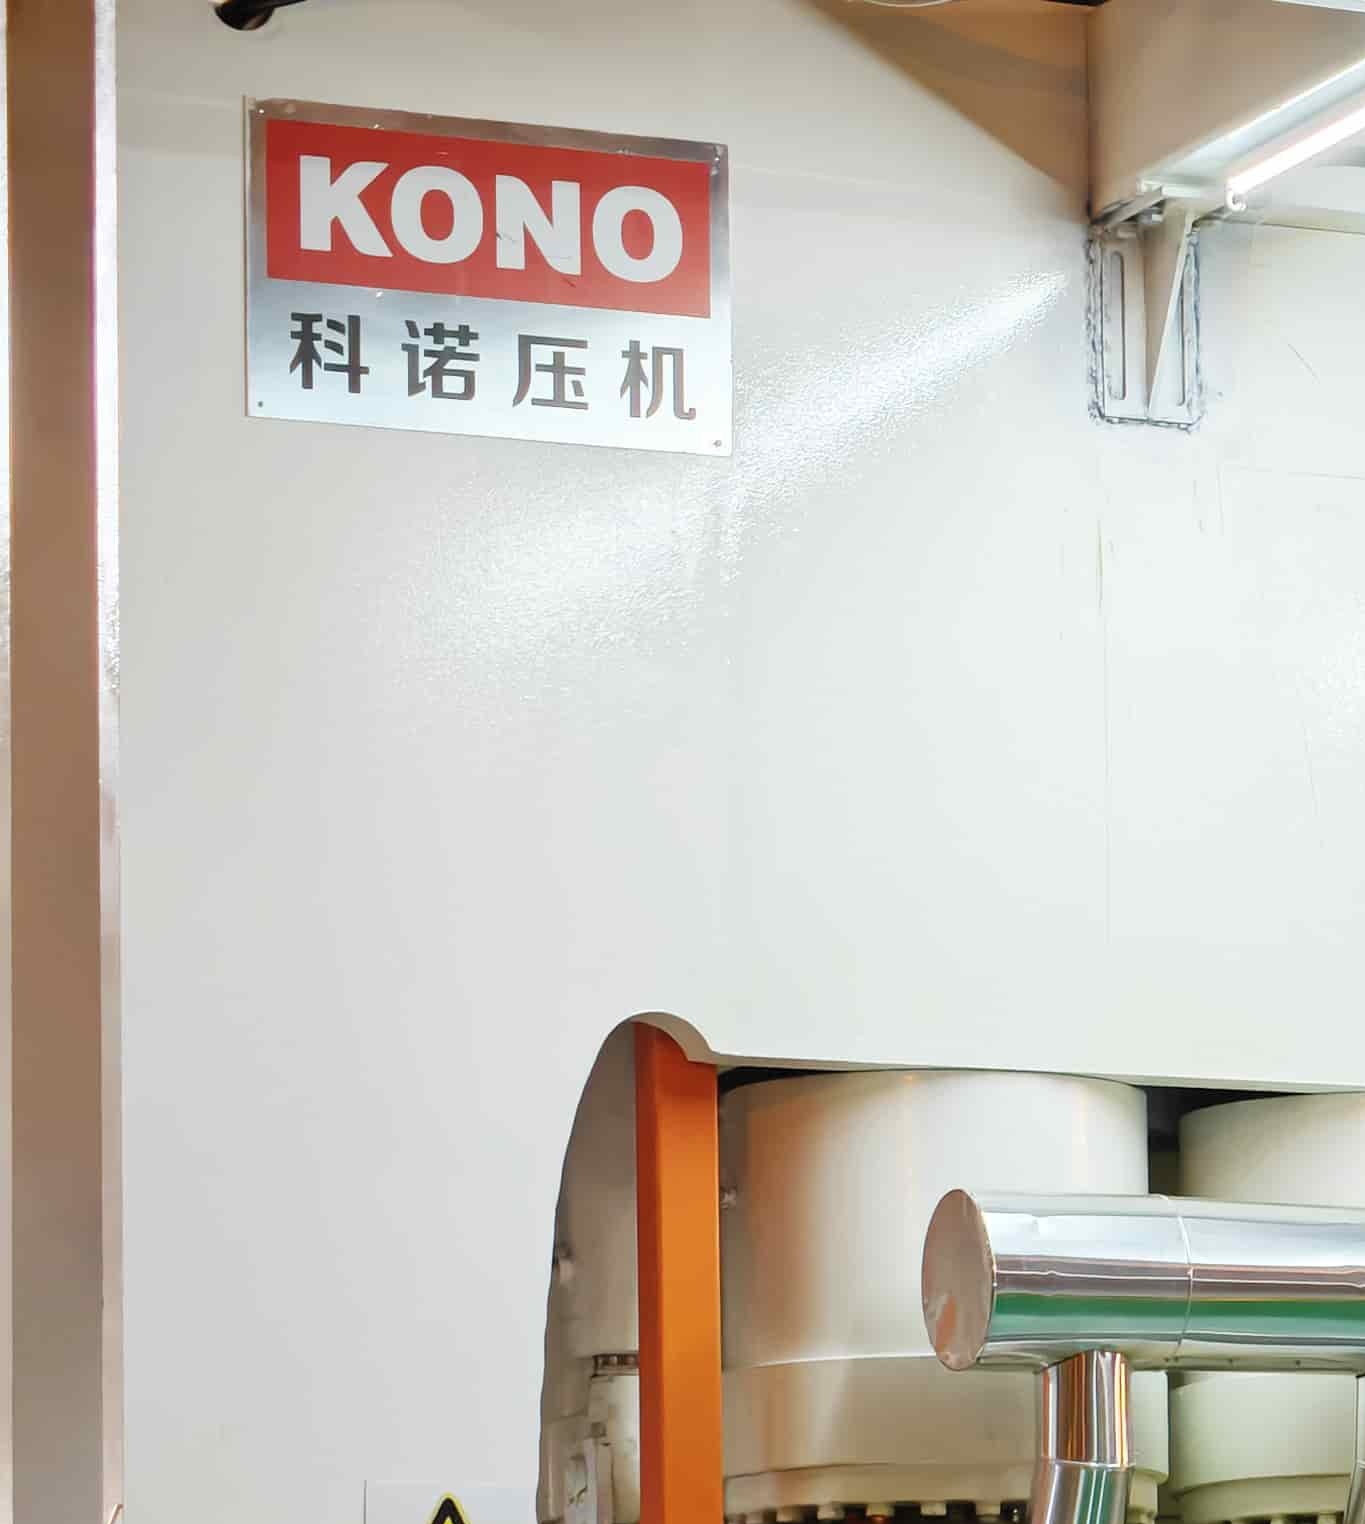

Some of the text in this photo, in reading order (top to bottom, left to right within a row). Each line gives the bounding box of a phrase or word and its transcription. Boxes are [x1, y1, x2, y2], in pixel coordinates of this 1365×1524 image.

[299, 155, 684, 283] KONO
[289, 312, 697, 421] 科诺压机
